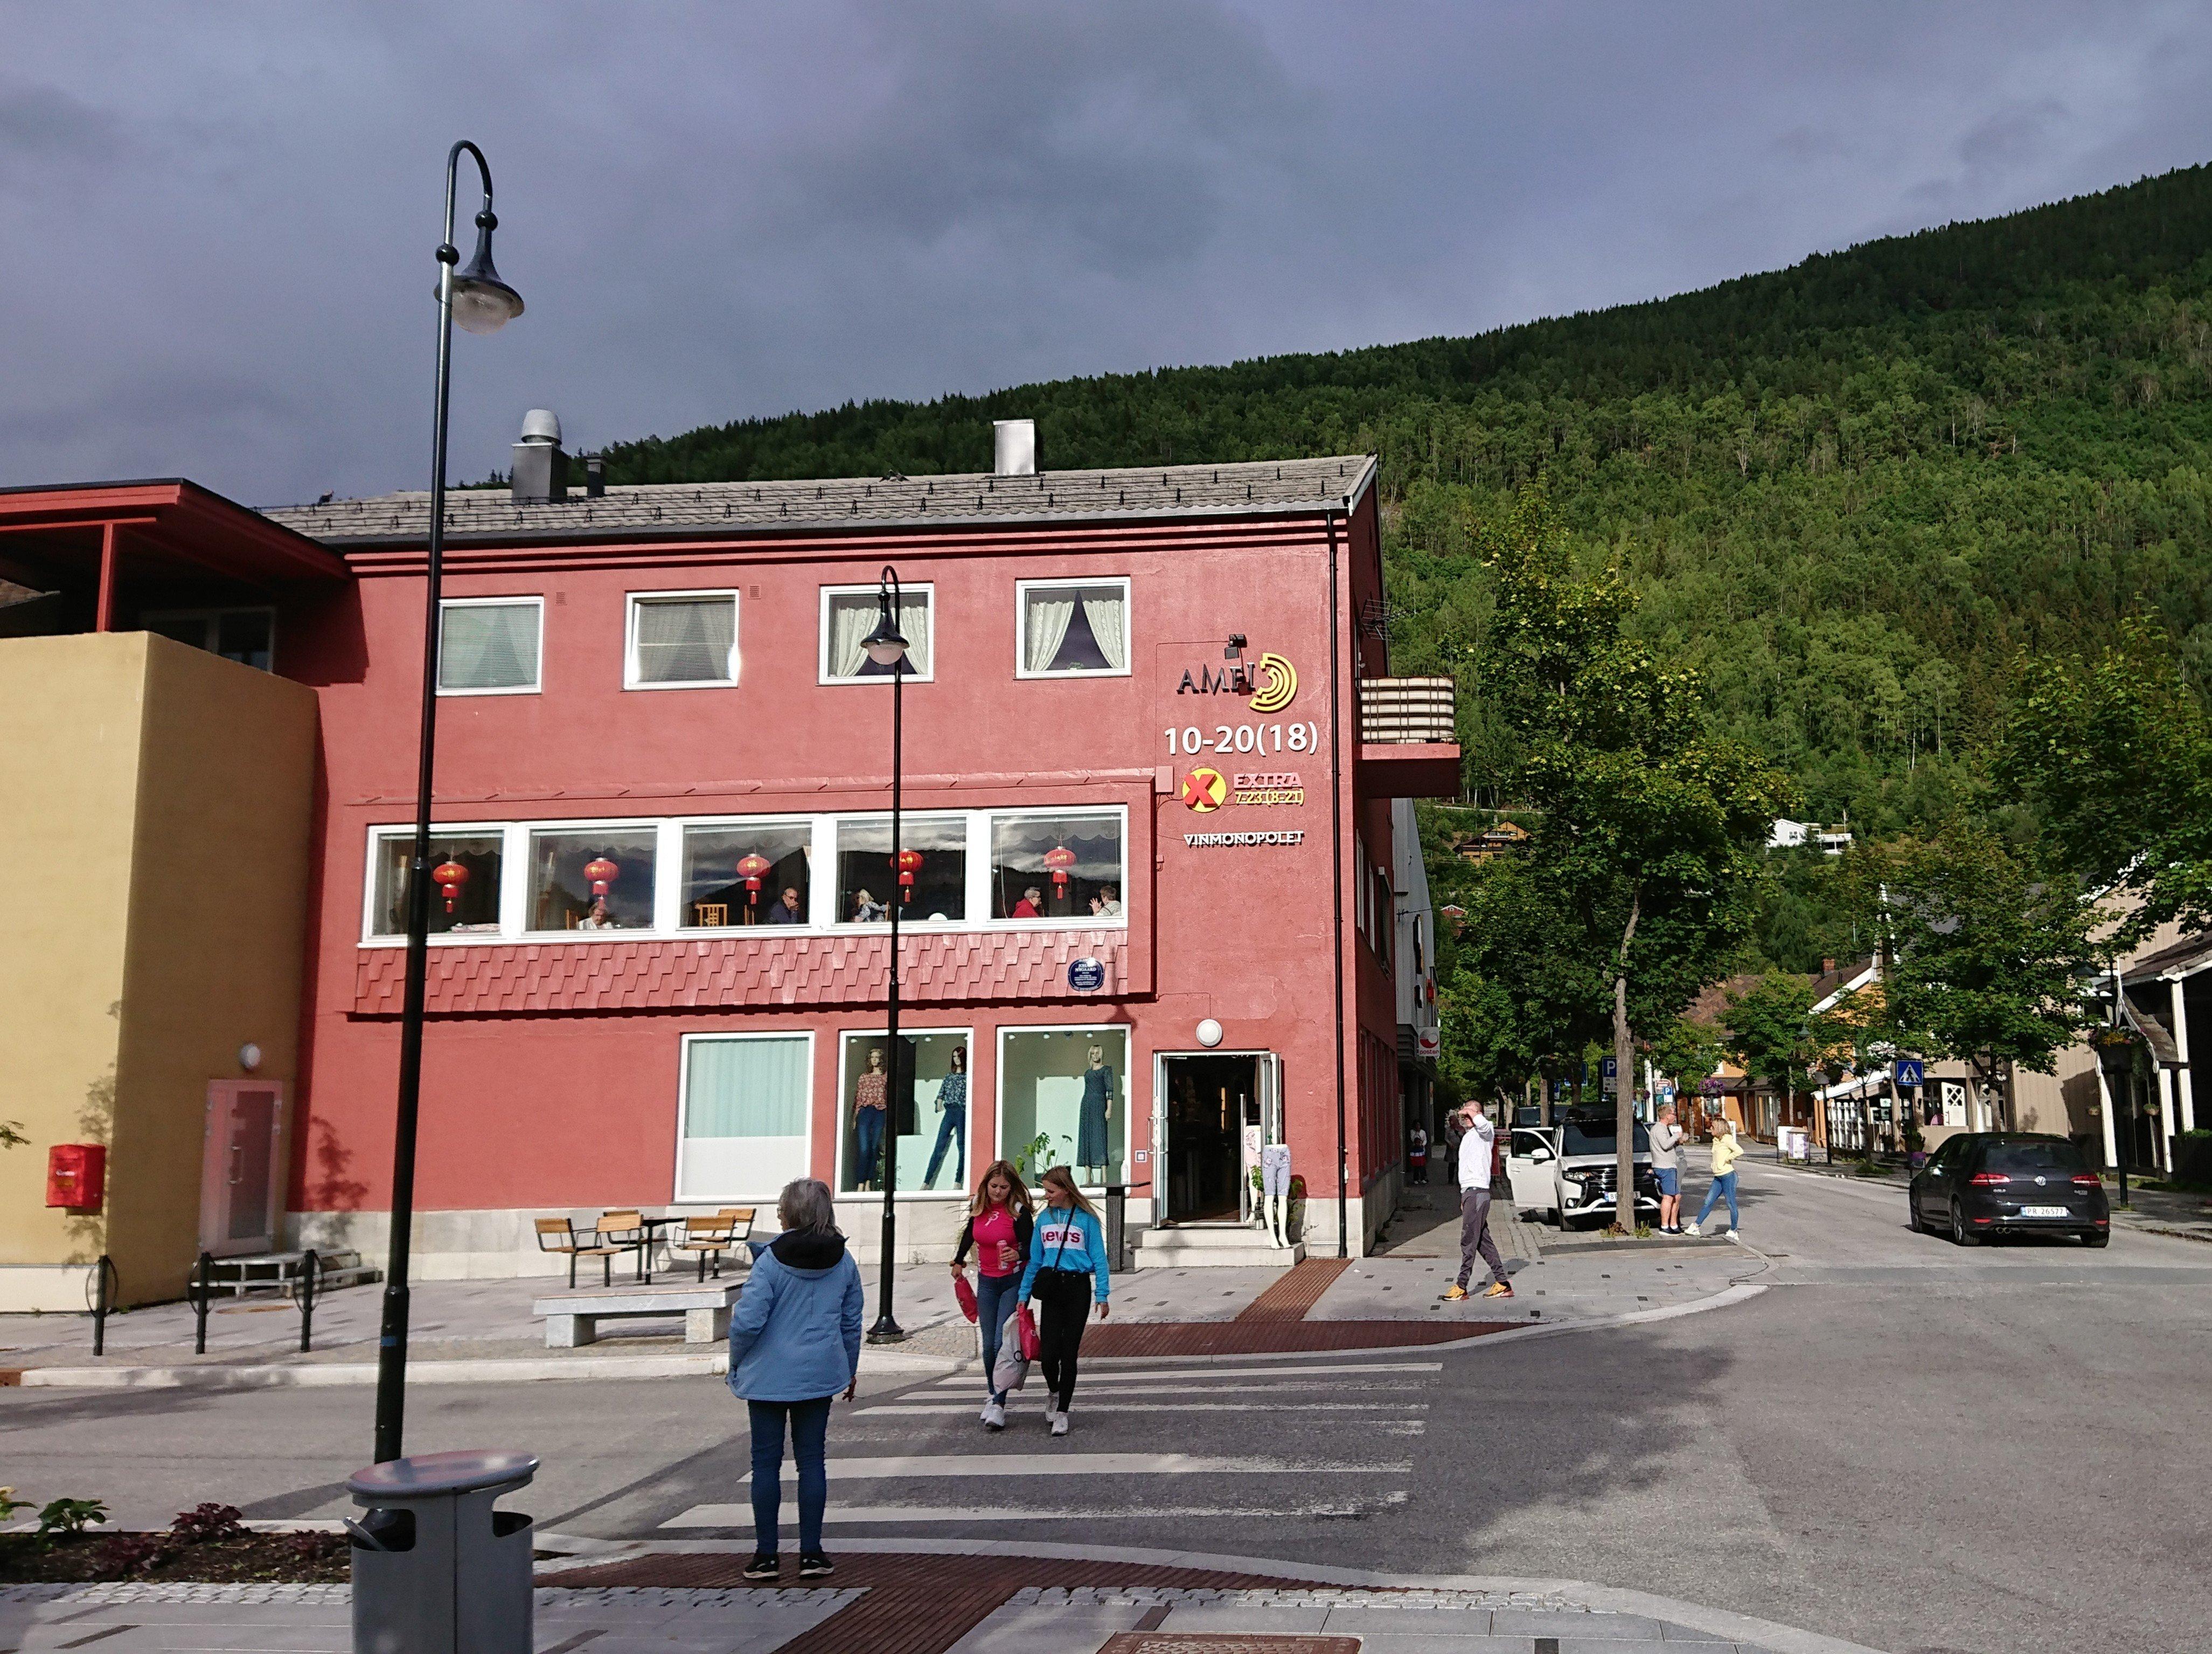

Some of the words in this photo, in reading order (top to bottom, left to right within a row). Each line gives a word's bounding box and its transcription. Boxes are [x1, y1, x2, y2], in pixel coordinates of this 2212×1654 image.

[1164, 721, 1318, 756] 10-20(18)
[1233, 772, 1303, 788] EXTRA
[1235, 792, 1263, 804] 7-23
[1266, 788, 1304, 806] (8-21)
[1184, 831, 1304, 846] VINMONOPOLET
[1607, 1060, 1616, 1074] P
